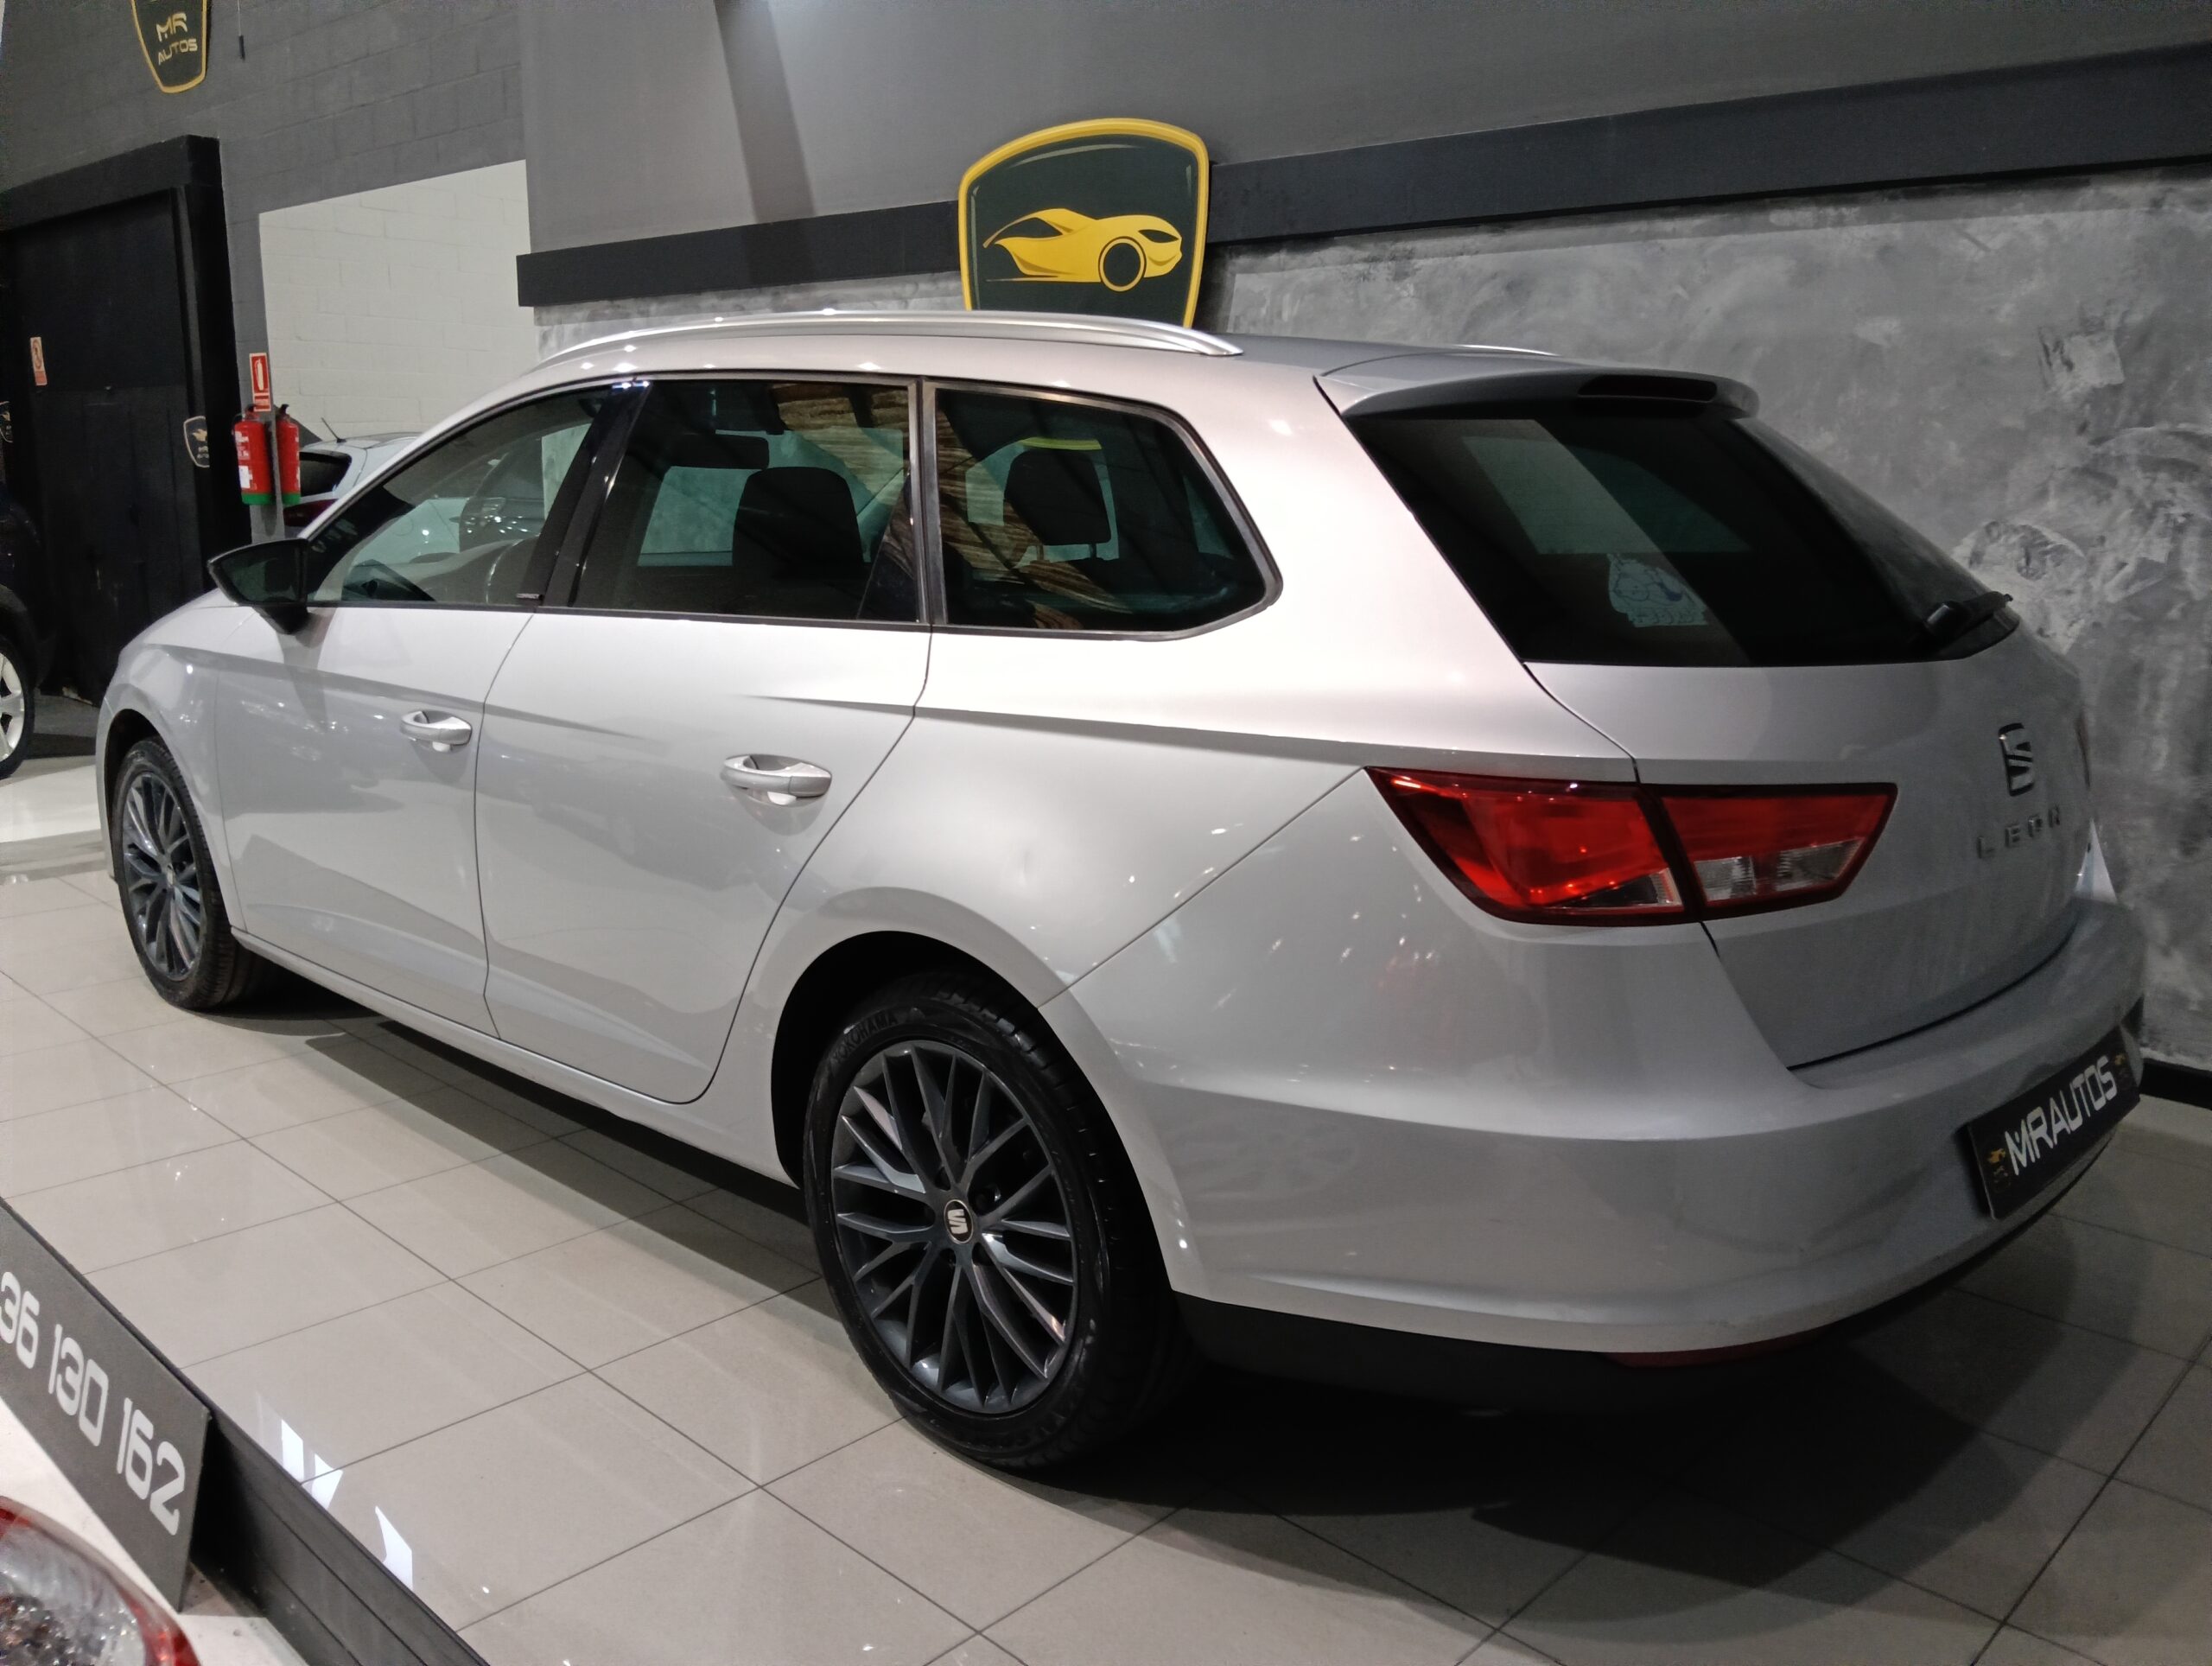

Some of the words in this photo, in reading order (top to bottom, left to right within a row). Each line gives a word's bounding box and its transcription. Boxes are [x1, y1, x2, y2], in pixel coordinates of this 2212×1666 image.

[156, 12, 188, 42] MR
[157, 38, 198, 66] AUTOS
[831, 1009, 899, 1063] YOKOHAMA
[48, 1324, 109, 1447] 130
[117, 1397, 186, 1536] 162
